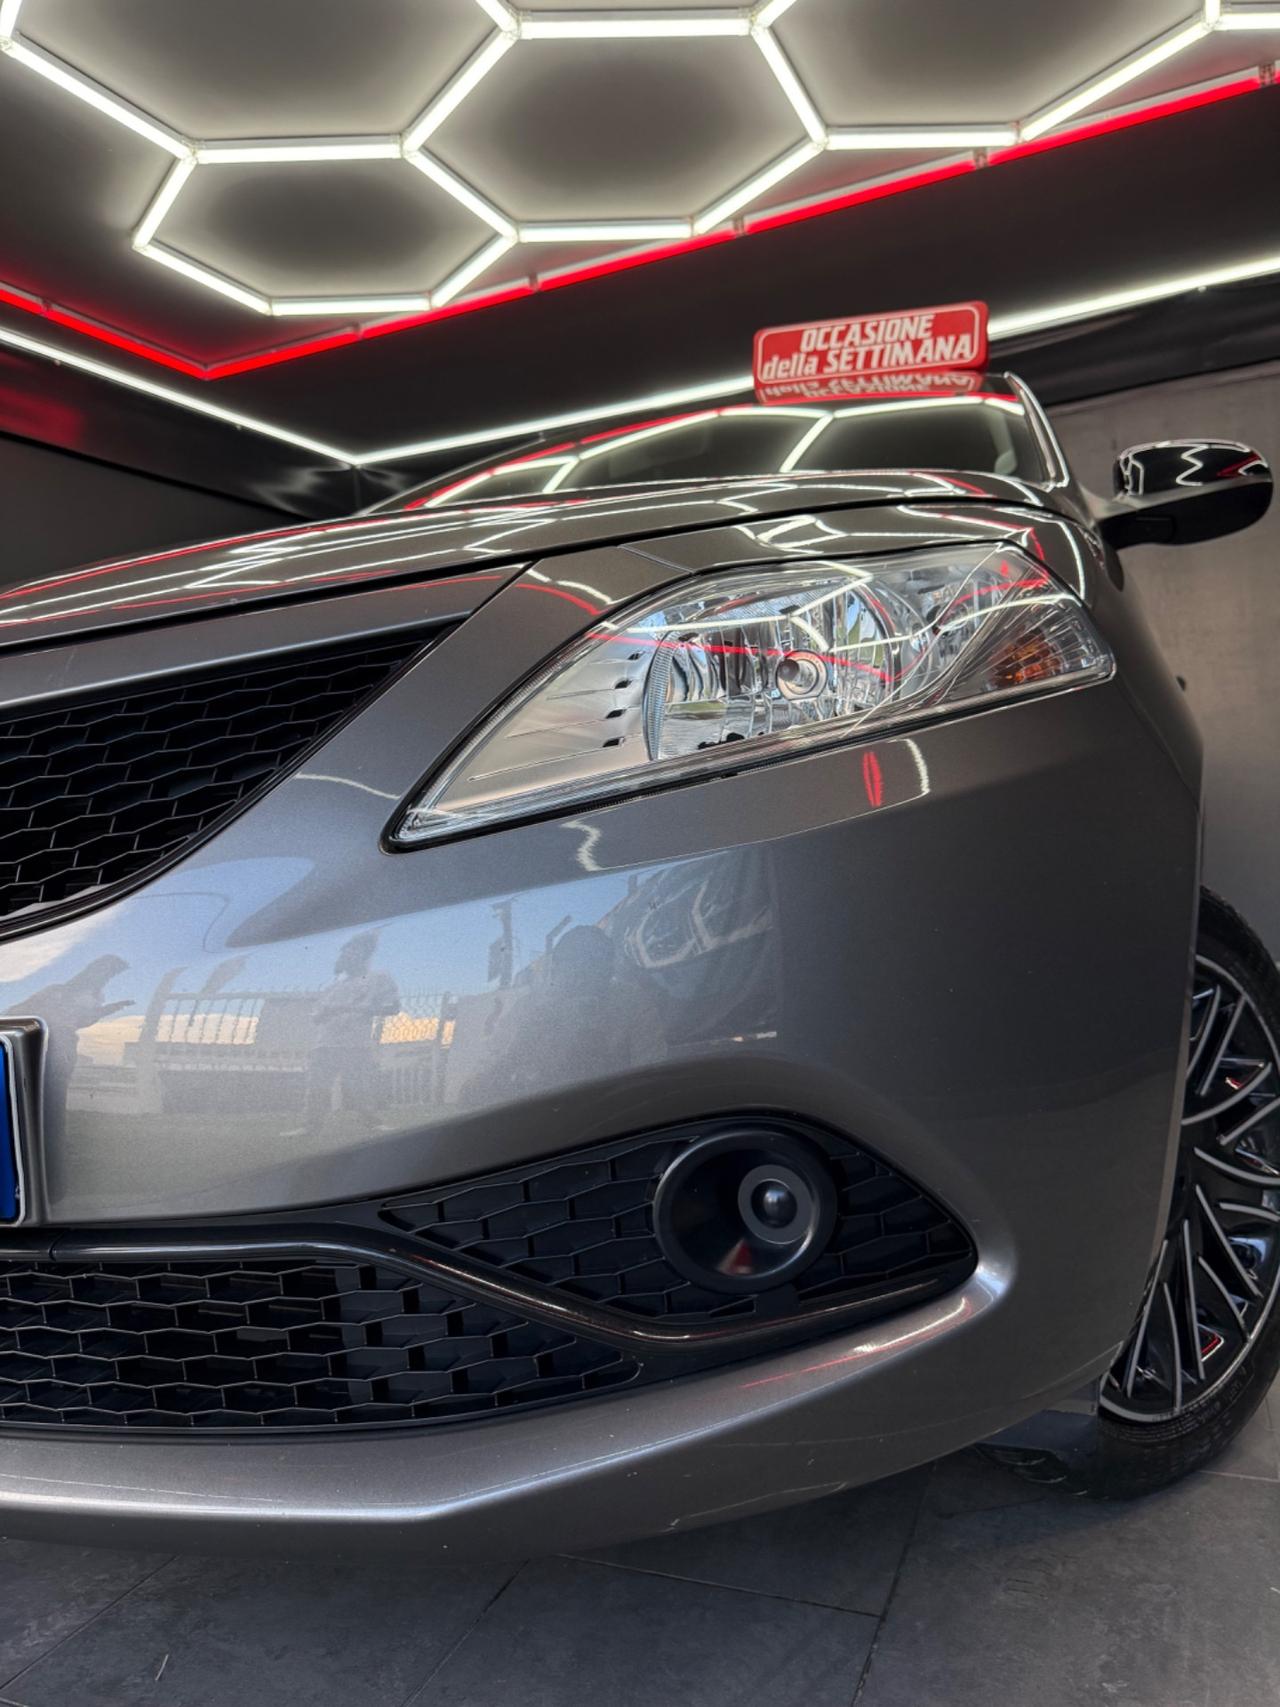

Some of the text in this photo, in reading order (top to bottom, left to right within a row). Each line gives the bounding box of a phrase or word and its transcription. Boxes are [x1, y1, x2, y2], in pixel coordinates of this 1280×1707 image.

[801, 314, 935, 353] OCCASIONE
[763, 334, 972, 380] della SETTIMANA
